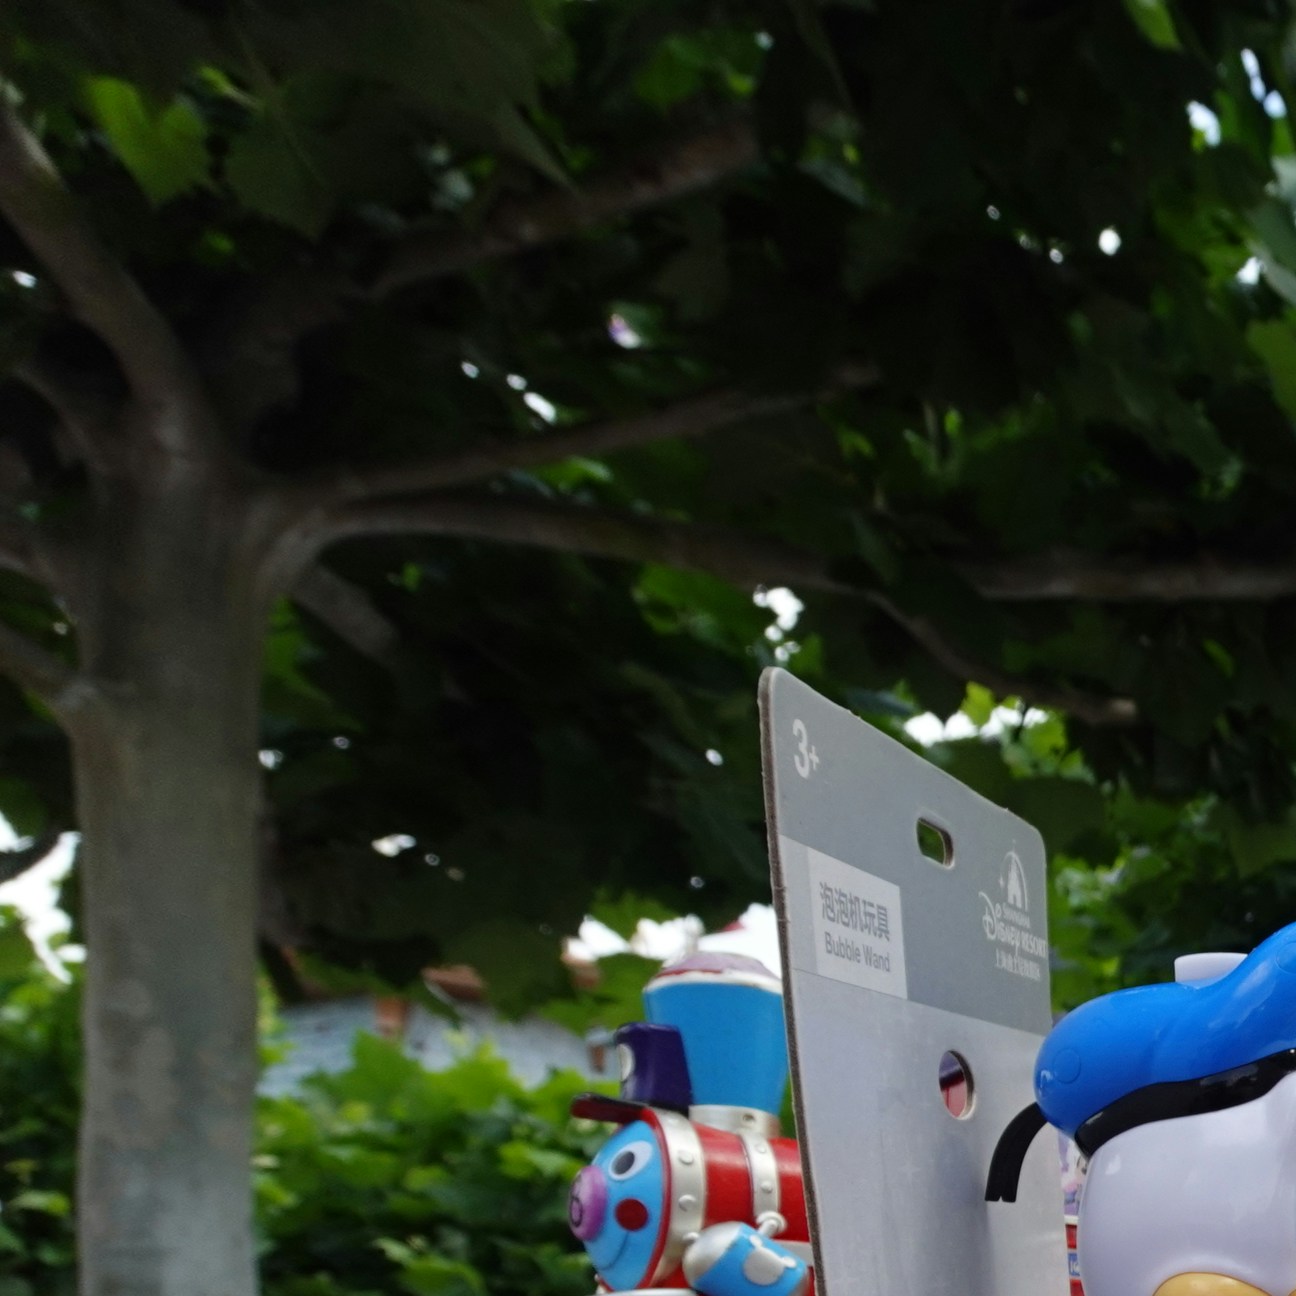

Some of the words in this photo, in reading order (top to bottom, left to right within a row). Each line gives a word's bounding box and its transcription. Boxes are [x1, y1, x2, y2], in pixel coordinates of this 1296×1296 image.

[792, 718, 819, 778] 3+
[819, 881, 890, 941] 泡泡机玩具
[824, 931, 861, 963] Bubble
[862, 944, 890, 972] Wand
